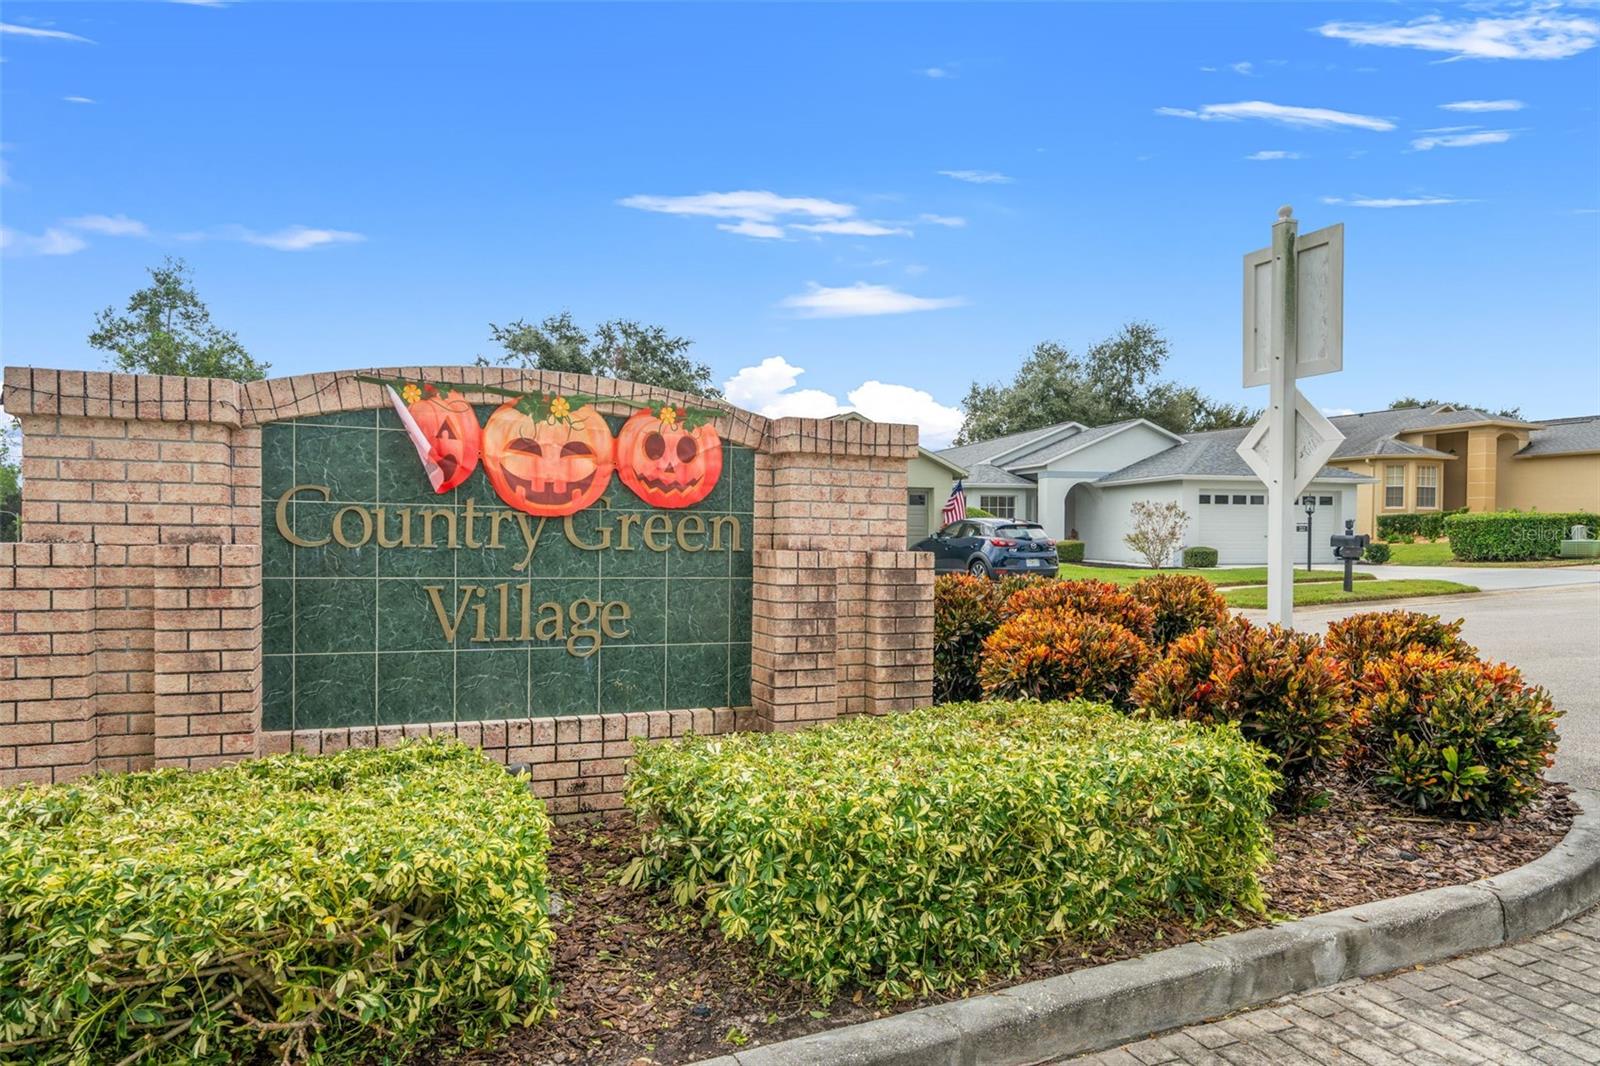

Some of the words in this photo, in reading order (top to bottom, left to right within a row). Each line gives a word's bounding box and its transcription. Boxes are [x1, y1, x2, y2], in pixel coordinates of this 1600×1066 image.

[275, 485, 548, 571] Country
[563, 497, 744, 552] Green
[424, 582, 632, 658] Village
